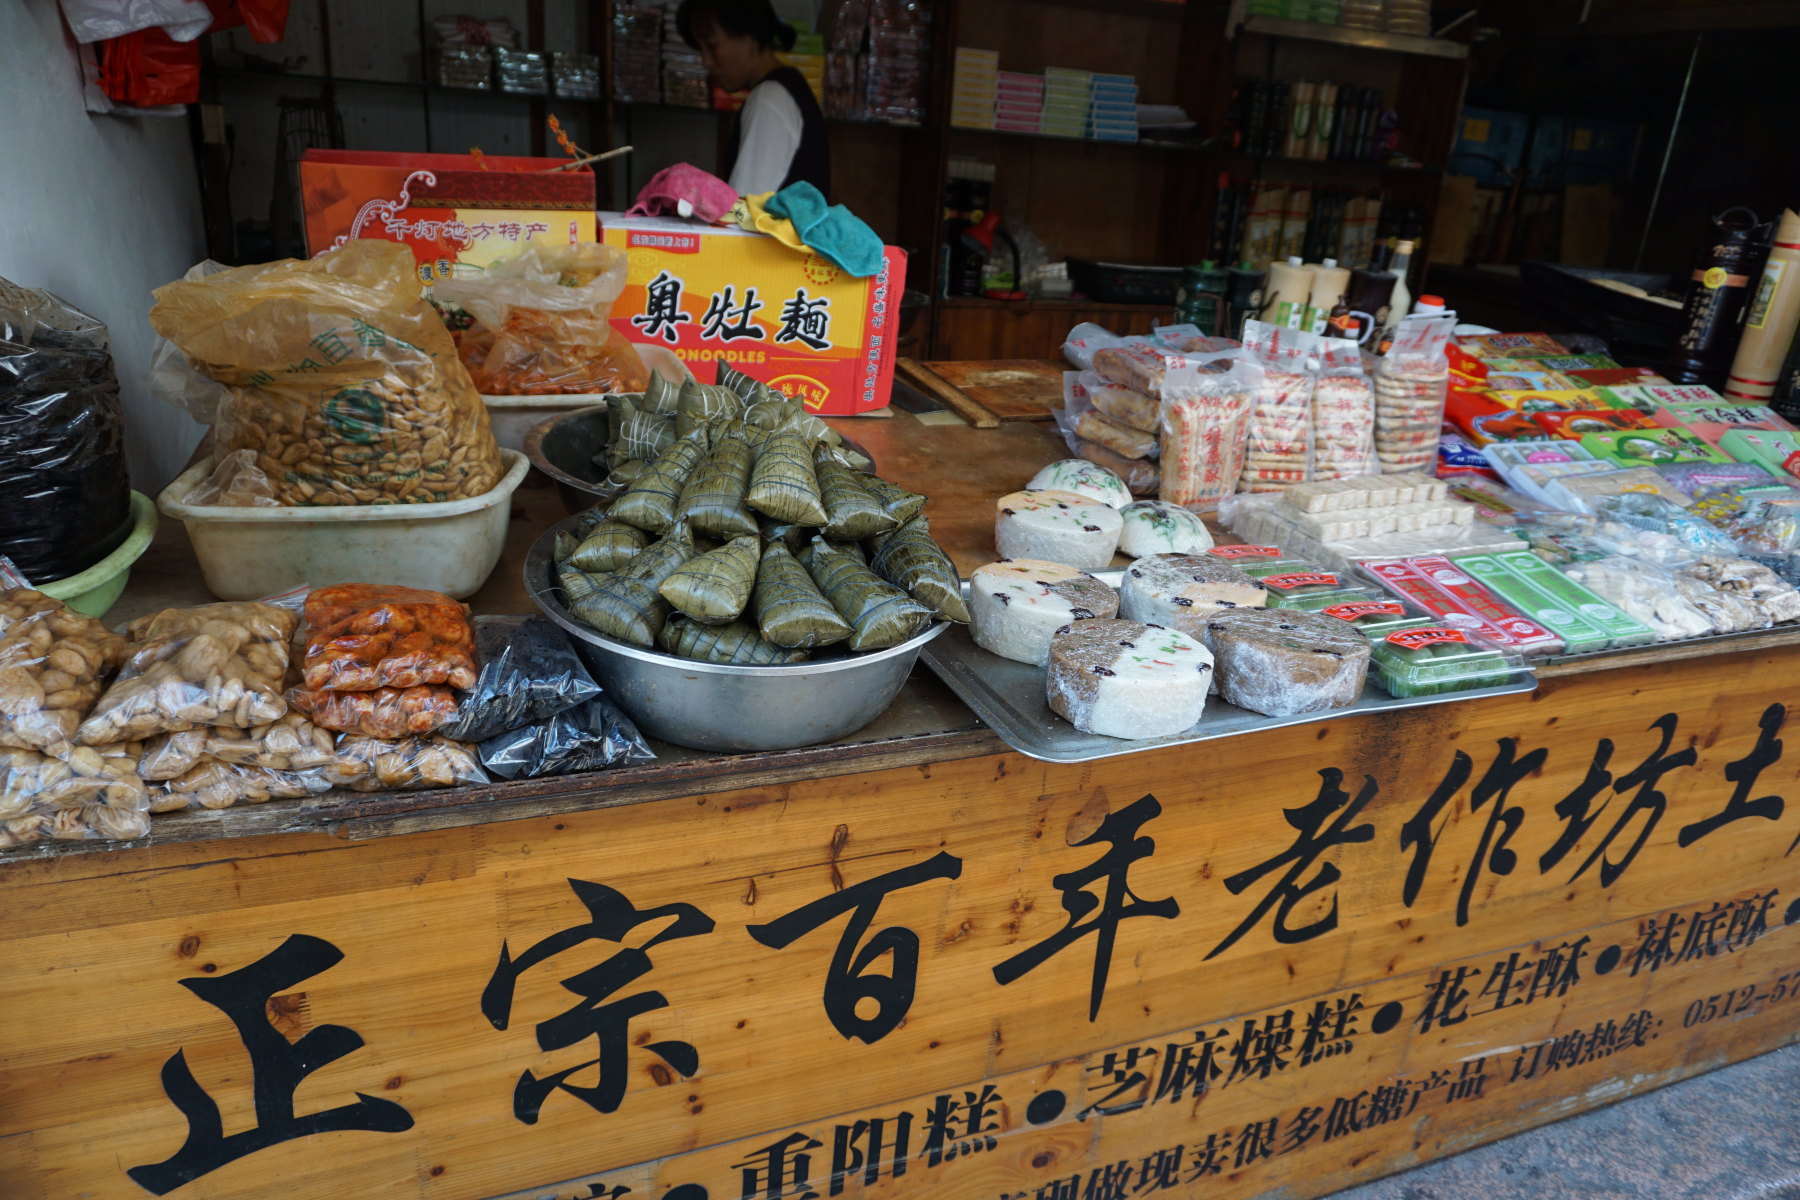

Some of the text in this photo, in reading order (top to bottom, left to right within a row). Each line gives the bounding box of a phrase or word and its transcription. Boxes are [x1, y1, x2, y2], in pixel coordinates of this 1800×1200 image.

[385, 218, 549, 241] 千灯地方特产
[676, 347, 767, 363] ONOODLES
[773, 384, 824, 403] 统风味
[127, 703, 1800, 1196] 正宗百年老作坊土
[731, 1085, 1002, 1200] 重阳糕
[1415, 935, 1591, 1035] 花生酥
[1625, 888, 1780, 978] 袜底酥
[1000, 1057, 1487, 1200] 做现卖很多低糖产品
